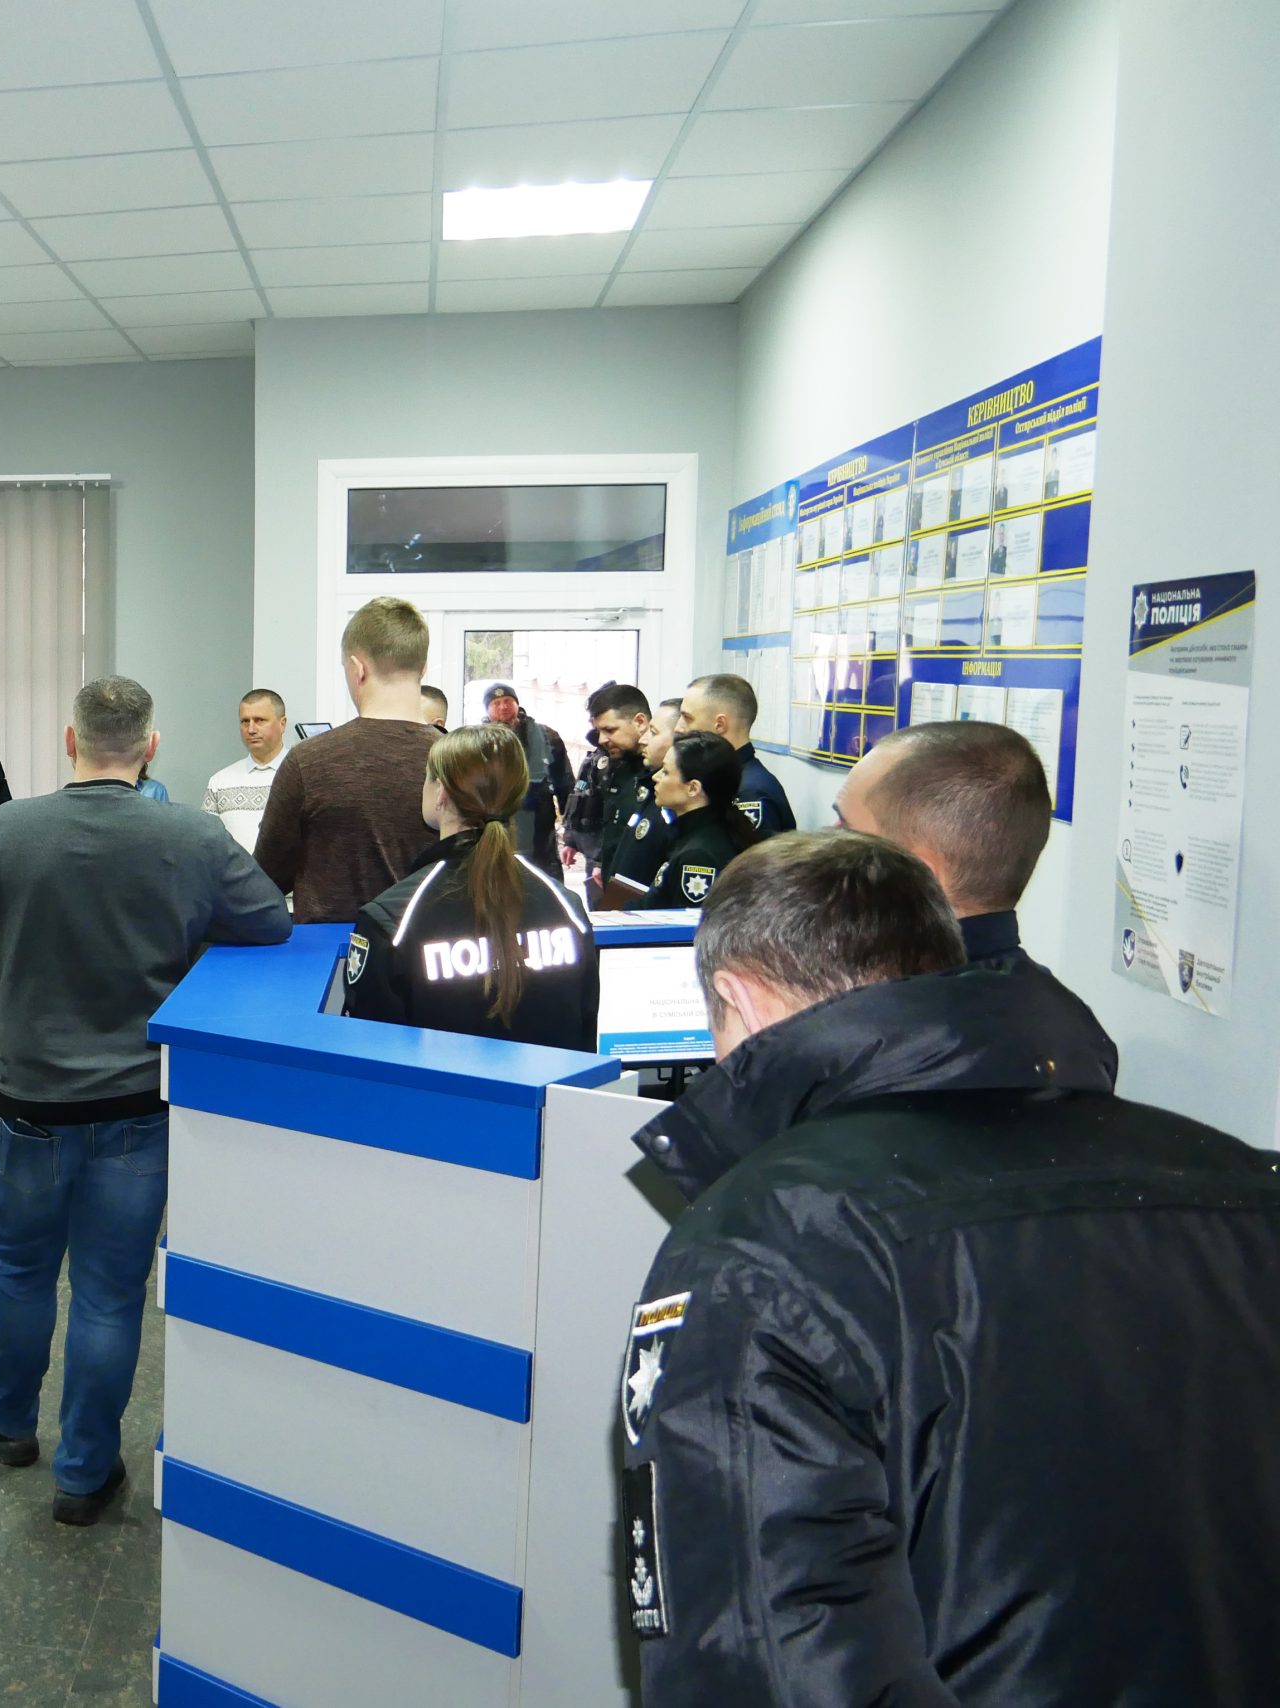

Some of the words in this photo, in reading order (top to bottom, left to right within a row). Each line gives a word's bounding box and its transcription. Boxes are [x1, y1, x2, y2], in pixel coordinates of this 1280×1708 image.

[967, 380, 1034, 428] КЕРІВНИЦТВО
[1151, 588, 1201, 604] НАЦІОНАЛЬНА
[1150, 603, 1201, 626] ПОЛІЦІЯ
[423, 927, 577, 981] ПОЛЦІЯ
